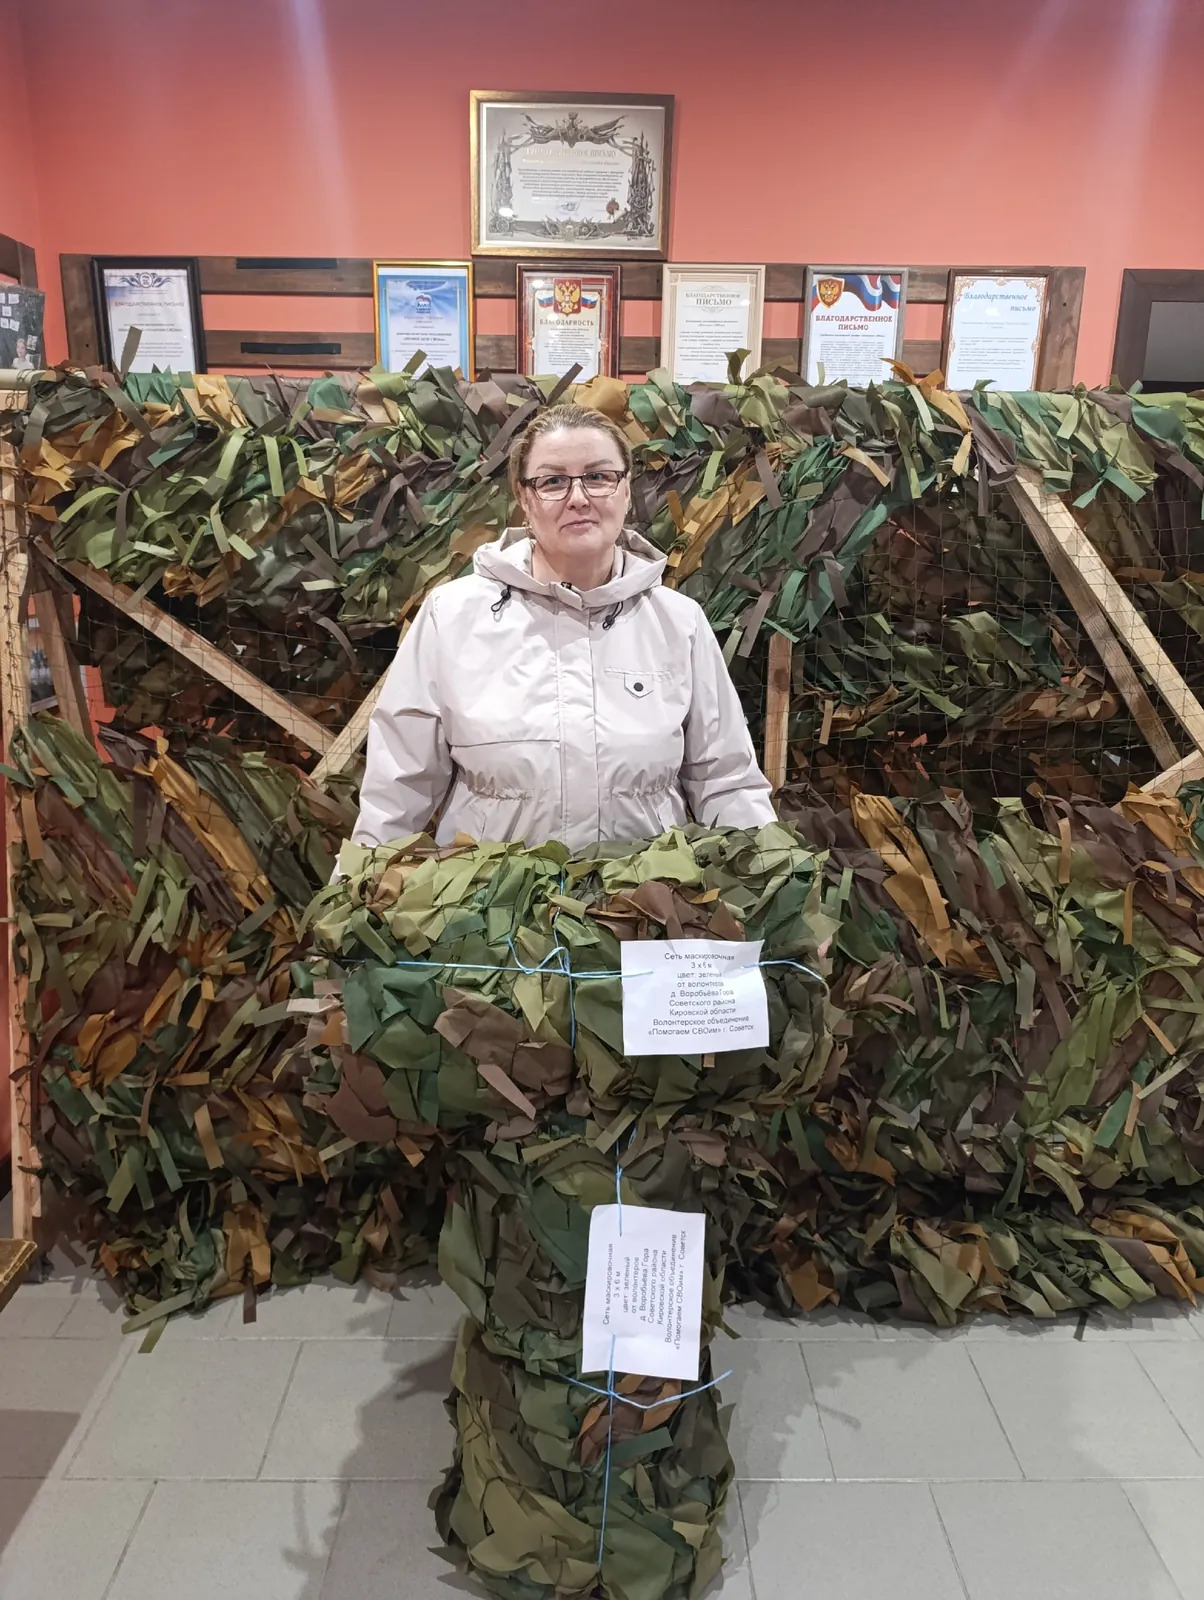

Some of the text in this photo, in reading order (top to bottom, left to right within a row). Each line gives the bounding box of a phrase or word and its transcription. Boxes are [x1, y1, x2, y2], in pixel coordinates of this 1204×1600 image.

[696, 298, 732, 306] ПИСЬМО
[963, 292, 1029, 302] Благодарственное
[815, 315, 893, 323] БЛАГОДАРСТВЕННОЕ
[664, 952, 734, 961] Сеть маскировочная
[713, 999, 735, 1007] района
[710, 1007, 736, 1015] области
[708, 1015, 749, 1025] объединение
[729, 1024, 754, 1032] Советск
[678, 1230, 686, 1260] Советск
[603, 1243, 613, 1325] Сеть маскировочная
[631, 1257, 640, 1313] от волонтеров
[648, 1250, 658, 1323] Советского района
[665, 1234, 677, 1343] Волонтерское объединение
[639, 1269, 648, 1311] Воробьёва
[657, 1284, 665, 1325] Кировской
